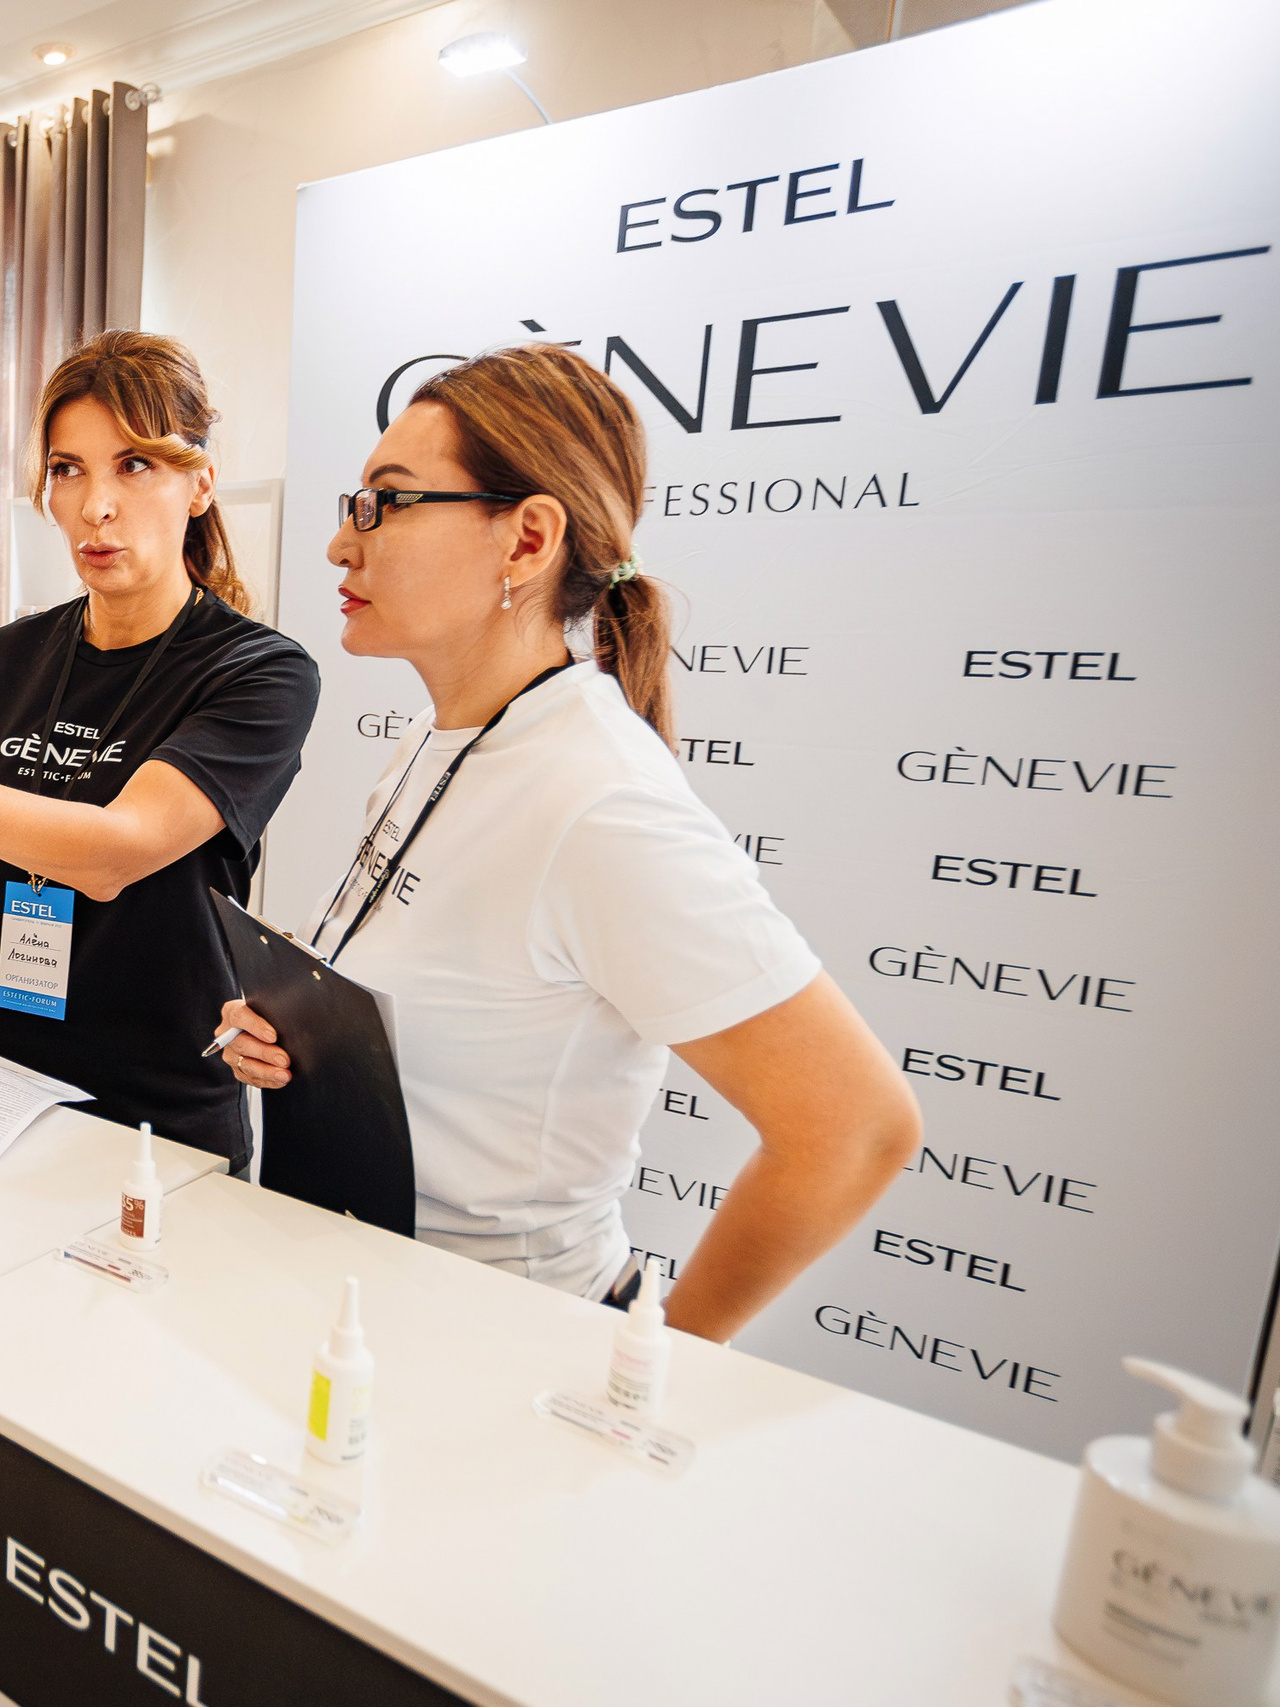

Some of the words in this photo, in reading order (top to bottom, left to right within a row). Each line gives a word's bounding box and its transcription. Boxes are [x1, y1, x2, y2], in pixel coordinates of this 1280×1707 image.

[616, 157, 897, 254] ESTEL
[376, 245, 1272, 436] NEVIE
[643, 472, 921, 517] ESSIONAL
[670, 644, 811, 676] NEVIE
[963, 650, 1138, 682] ESTEL
[0, 732, 127, 768] GÈNEIE
[53, 721, 101, 740] ESTEL
[680, 738, 756, 766] TEL
[897, 746, 1178, 799] GÈNEVIE
[382, 819, 401, 842] ESTEL
[931, 854, 1099, 898] ESTEL
[11, 900, 57, 919] ESTEL
[19, 933, 50, 949] Алёна
[5, 973, 59, 990] ОРГАНИЗАТОР
[869, 945, 1137, 1013] GÈNEVIE
[902, 1047, 1063, 1102] ESTEL
[903, 1146, 1099, 1214] NEVIE
[873, 1229, 1027, 1293] ESTEL
[815, 1304, 1062, 1403] GÈNEVIE
[6, 1535, 210, 1707] ESTEL
